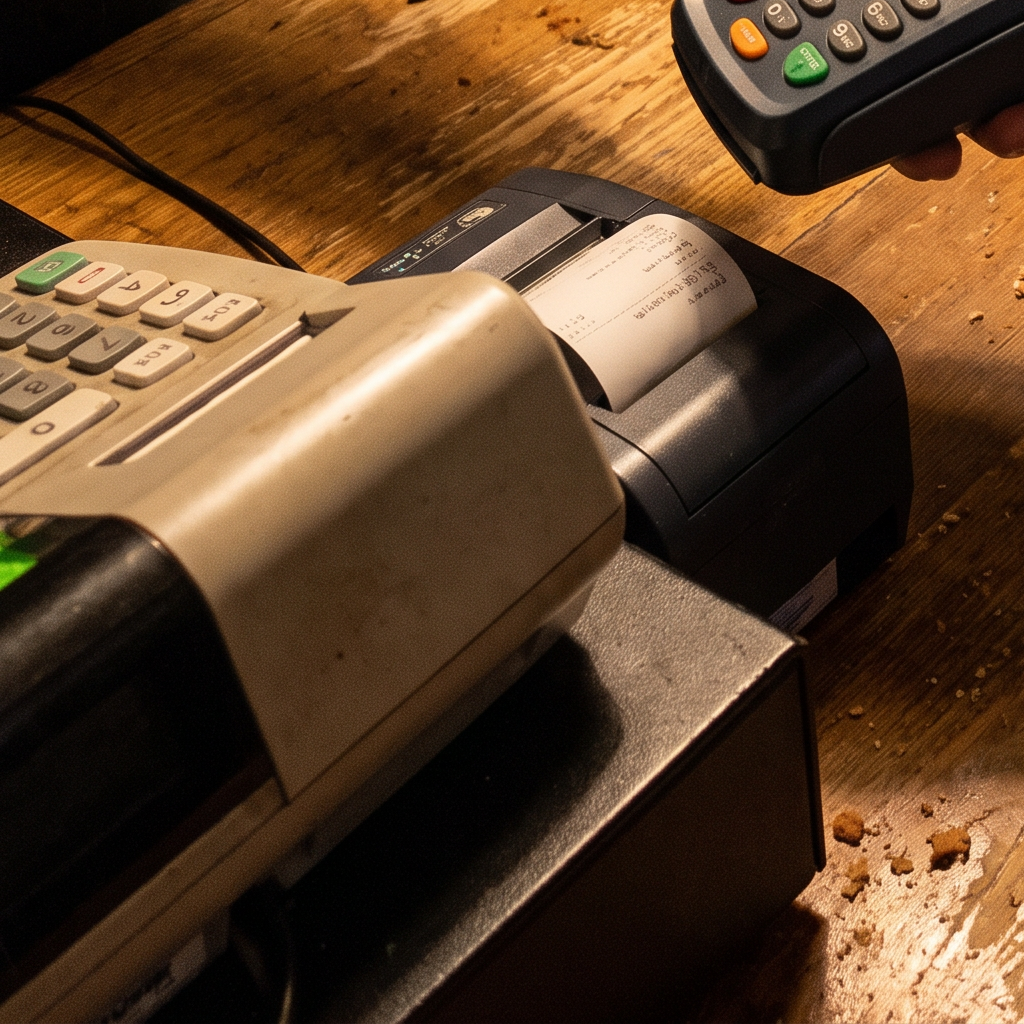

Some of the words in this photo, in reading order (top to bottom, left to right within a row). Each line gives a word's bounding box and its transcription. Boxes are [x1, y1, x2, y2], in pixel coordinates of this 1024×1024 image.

[767, 3, 782, 16] 0
[867, 1, 884, 16] 6
[832, 23, 848, 37] 9
